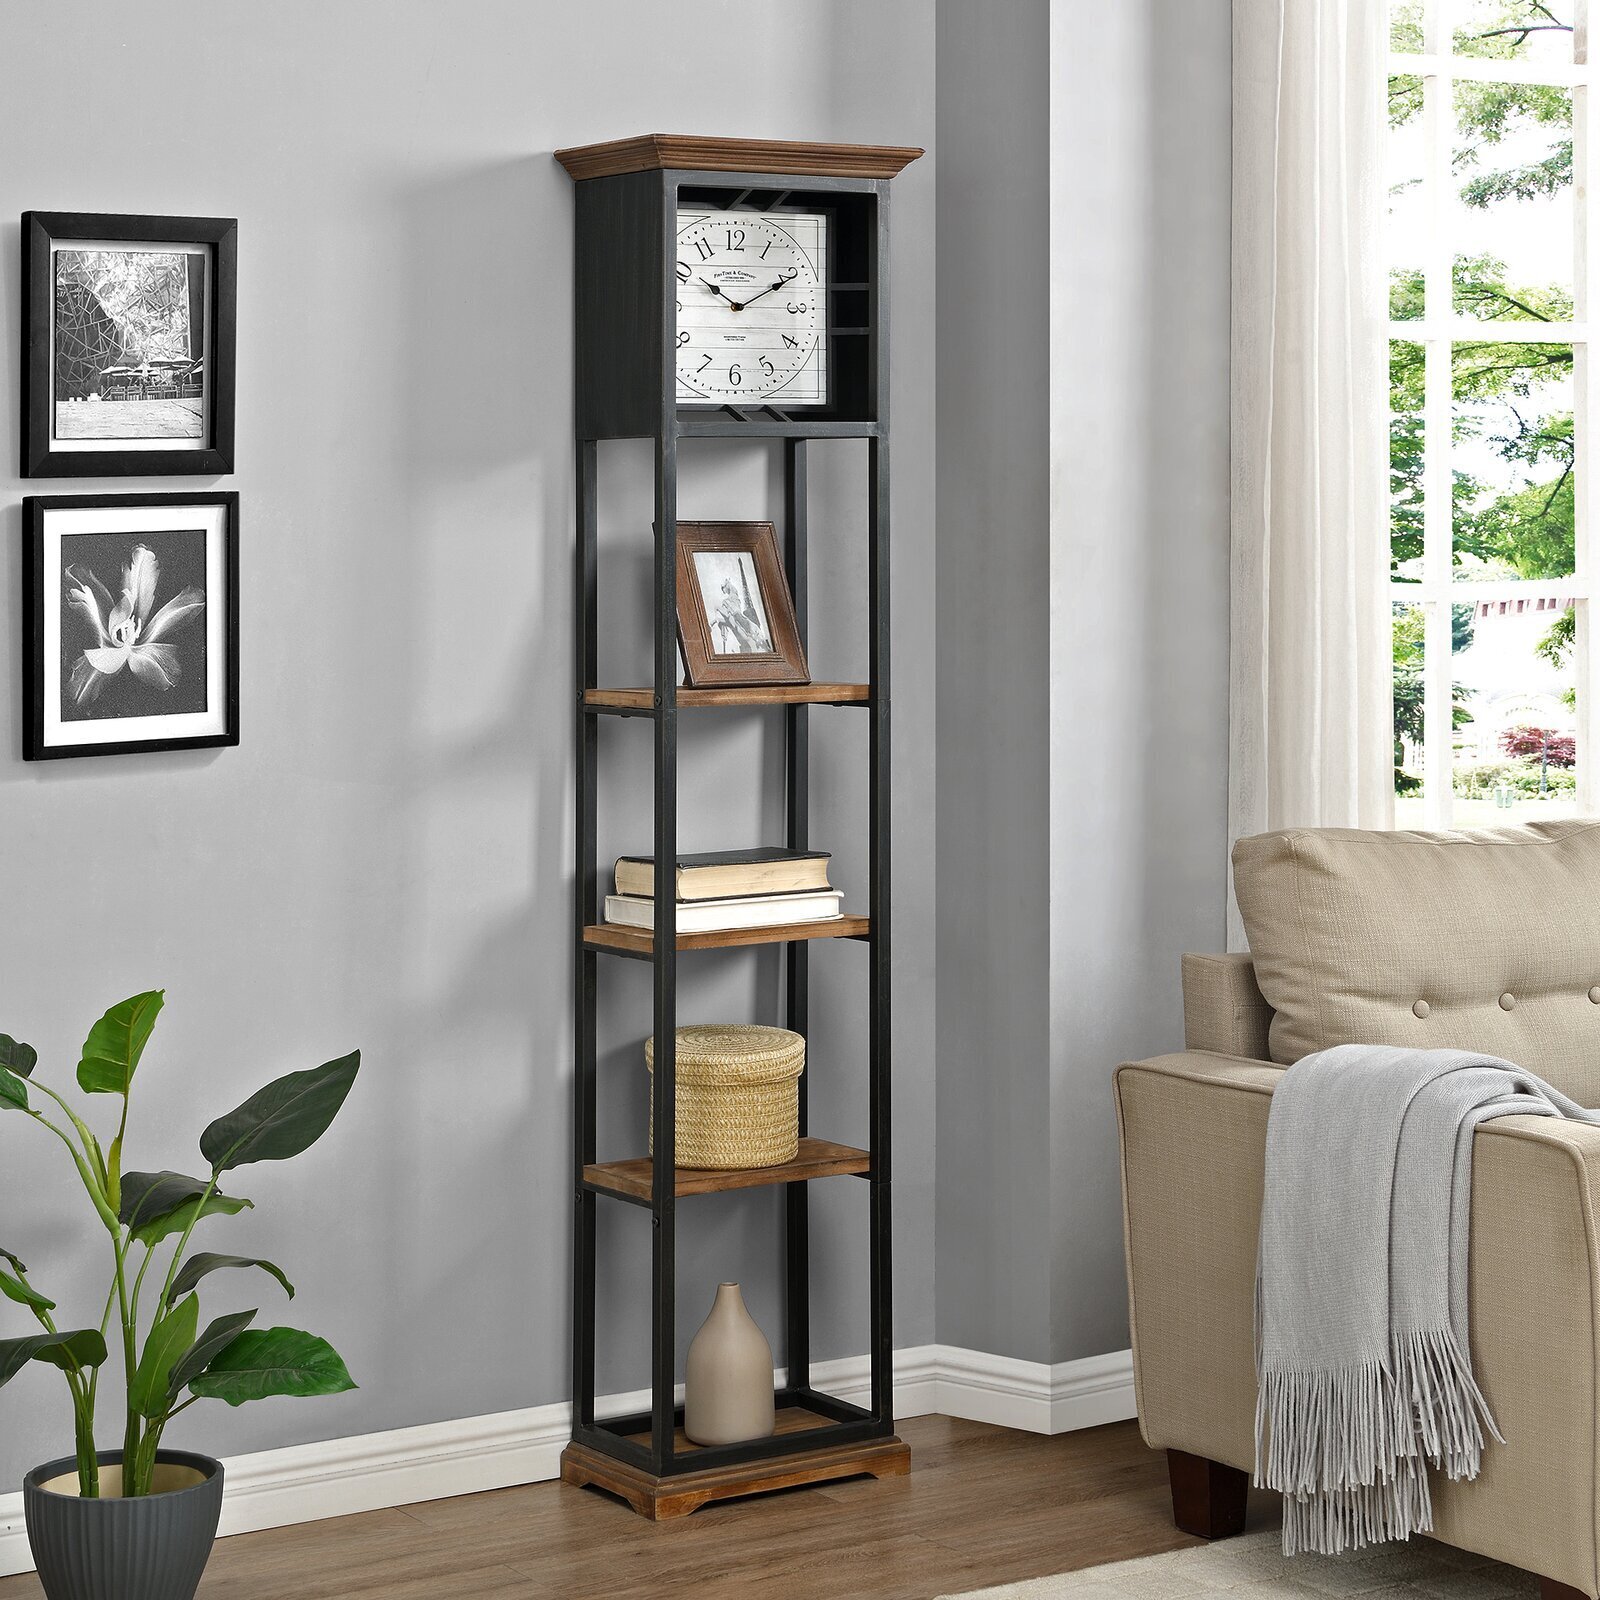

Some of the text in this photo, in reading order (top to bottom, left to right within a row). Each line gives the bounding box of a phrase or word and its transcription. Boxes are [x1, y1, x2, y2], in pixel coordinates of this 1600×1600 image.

[694, 237, 715, 261] 11
[726, 230, 745, 252] 12
[759, 240, 772, 260] 1
[778, 267, 798, 285] 2
[787, 302, 807, 314] 3
[781, 334, 799, 349] 4
[697, 354, 713, 373] 7
[759, 355, 774, 377] 5
[729, 364, 742, 386] 6
